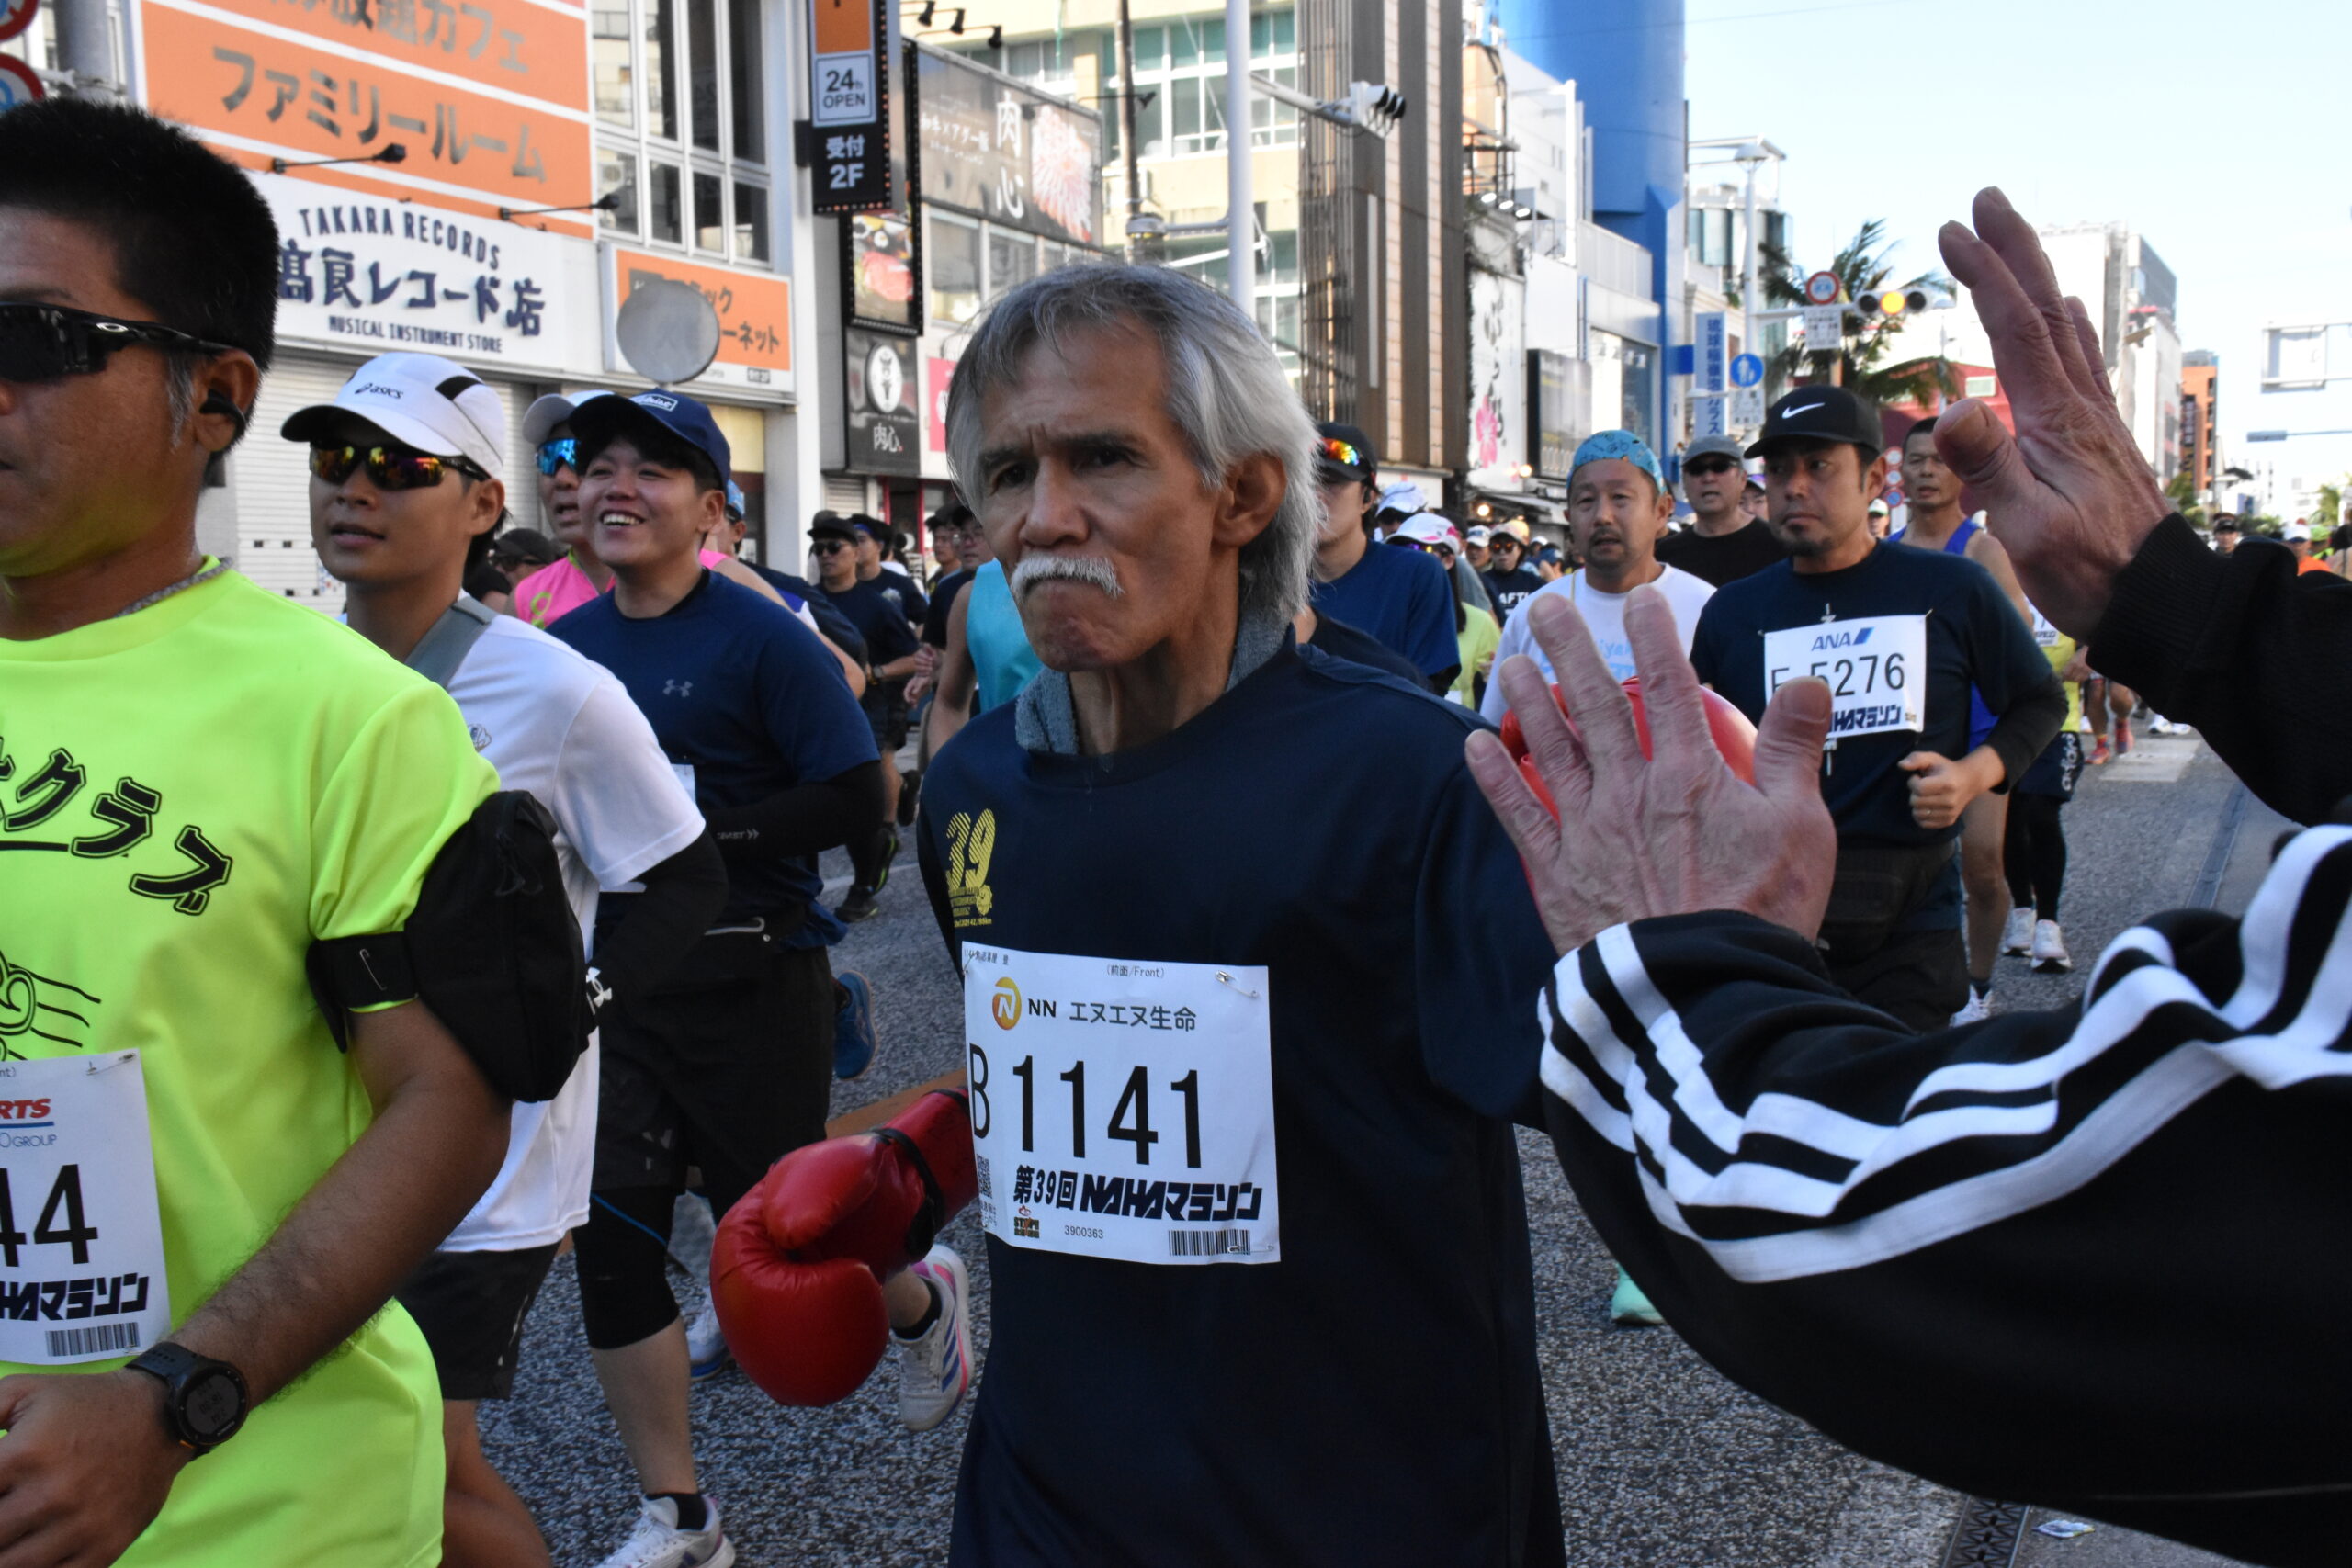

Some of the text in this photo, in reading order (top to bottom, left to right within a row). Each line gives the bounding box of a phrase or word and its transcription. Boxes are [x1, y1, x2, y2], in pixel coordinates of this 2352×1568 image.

[212, 46, 547, 183] ファミリールーム
[823, 94, 865, 108] OPEN
[826, 135, 865, 159] 受付
[830, 164, 865, 189] 2F
[299, 206, 500, 270] TAKARA RECORDS
[329, 315, 502, 353] MUSICAL INSTRUMENT STORE
[721, 321, 779, 354] ーネット
[371, 386, 403, 400] asics
[1811, 632, 1851, 651] ANA
[1831, 705, 1901, 732] HAマラソン
[0, 738, 232, 916] クラブ
[946, 808, 995, 889] 39
[1028, 998, 1196, 1032] NN エヌエヌ生命
[969, 1043, 1202, 1168] B 1141
[1064, 1225, 1103, 1239] 3900363
